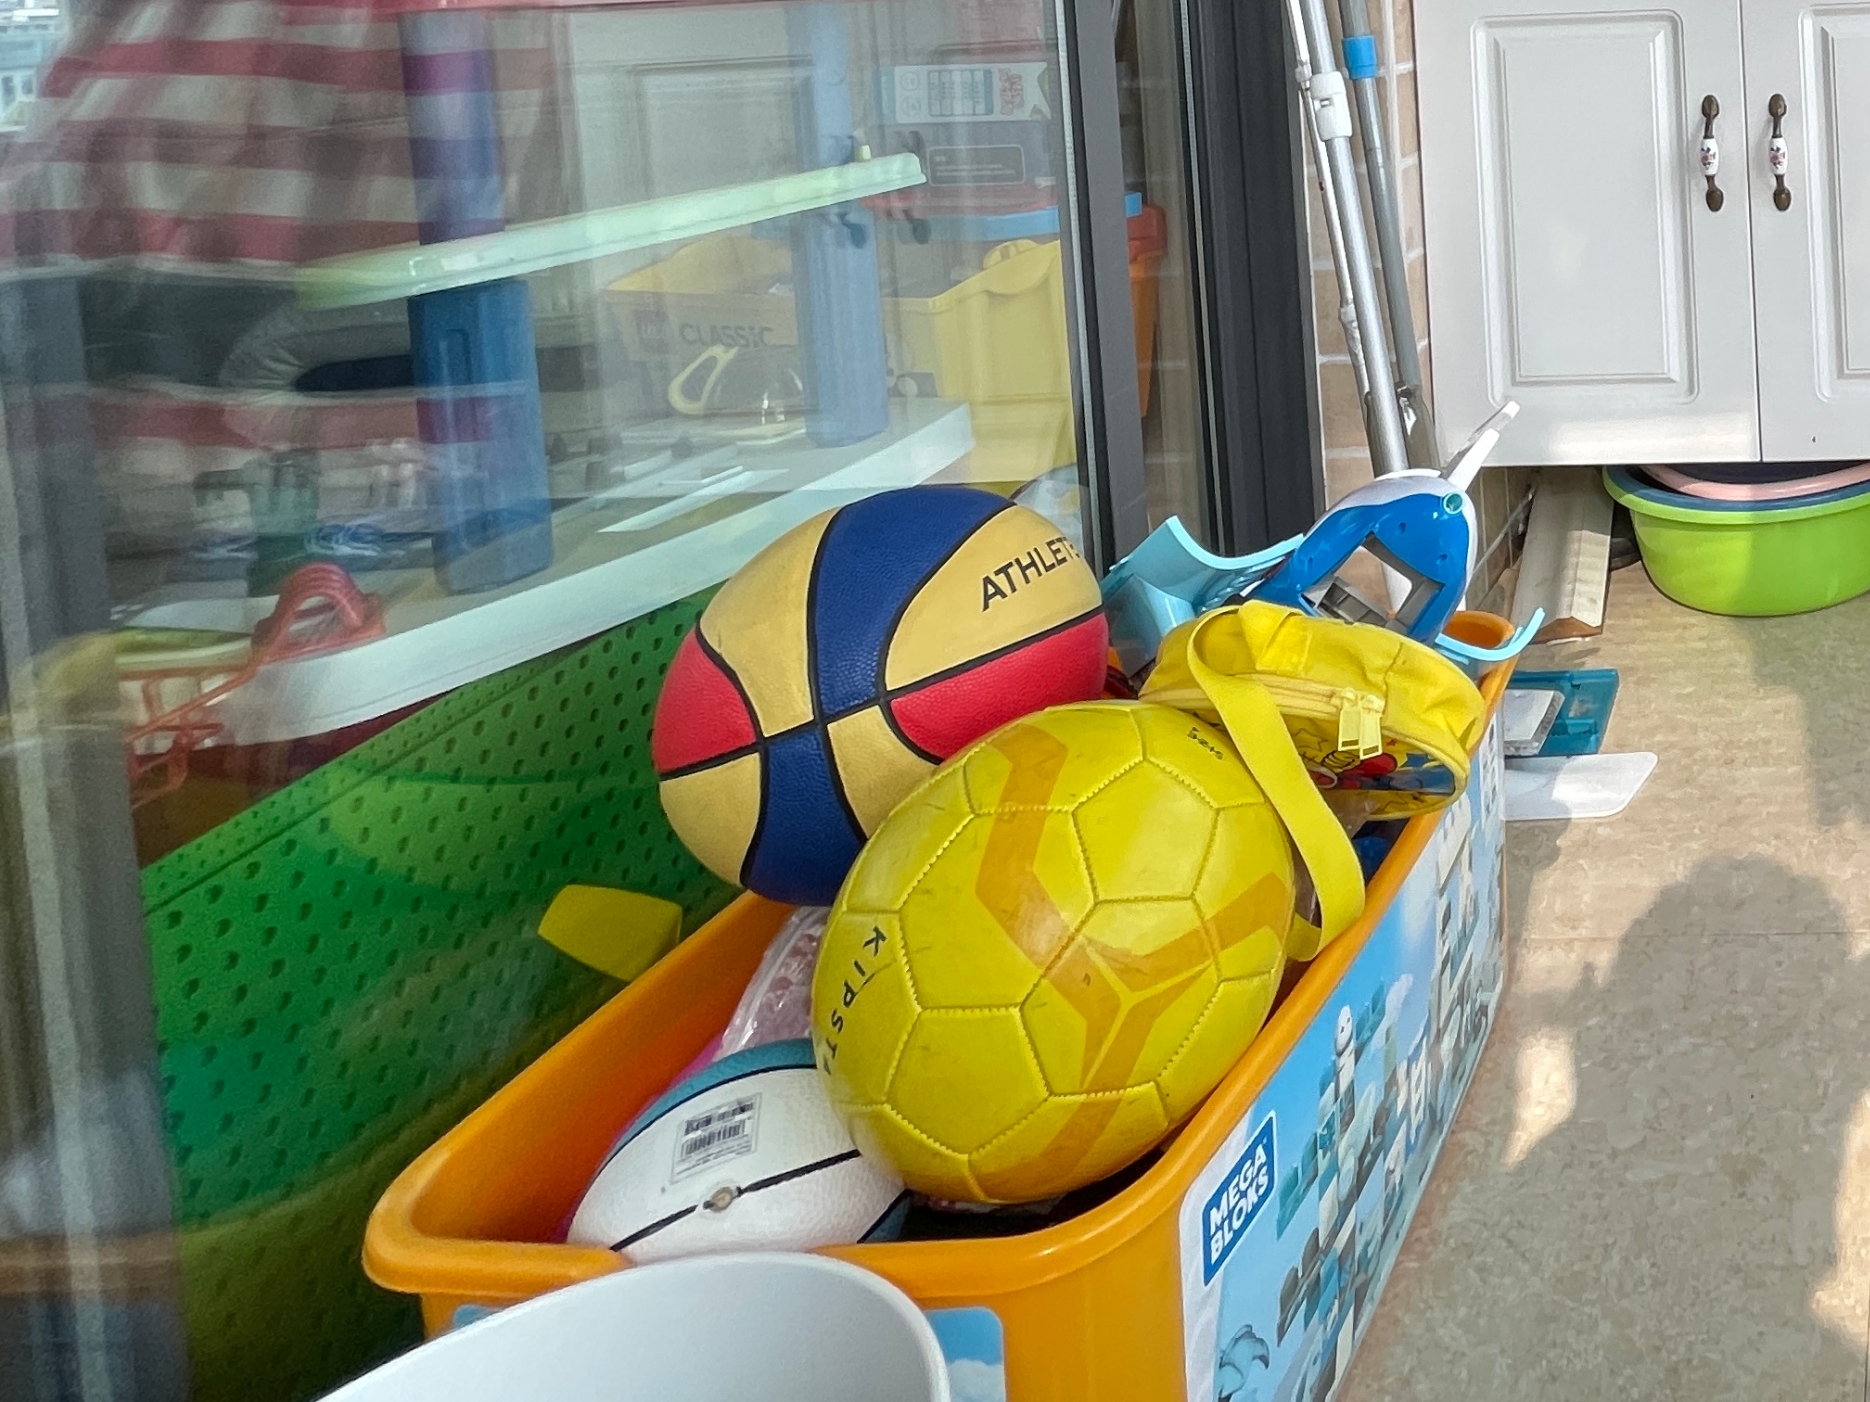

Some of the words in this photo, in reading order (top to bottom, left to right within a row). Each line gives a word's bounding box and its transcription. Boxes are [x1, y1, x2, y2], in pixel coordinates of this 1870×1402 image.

[680, 322, 775, 349] CLASSIC
[1209, 1142, 1267, 1236] MEGA
[1211, 1165, 1269, 1265] BLOKS
